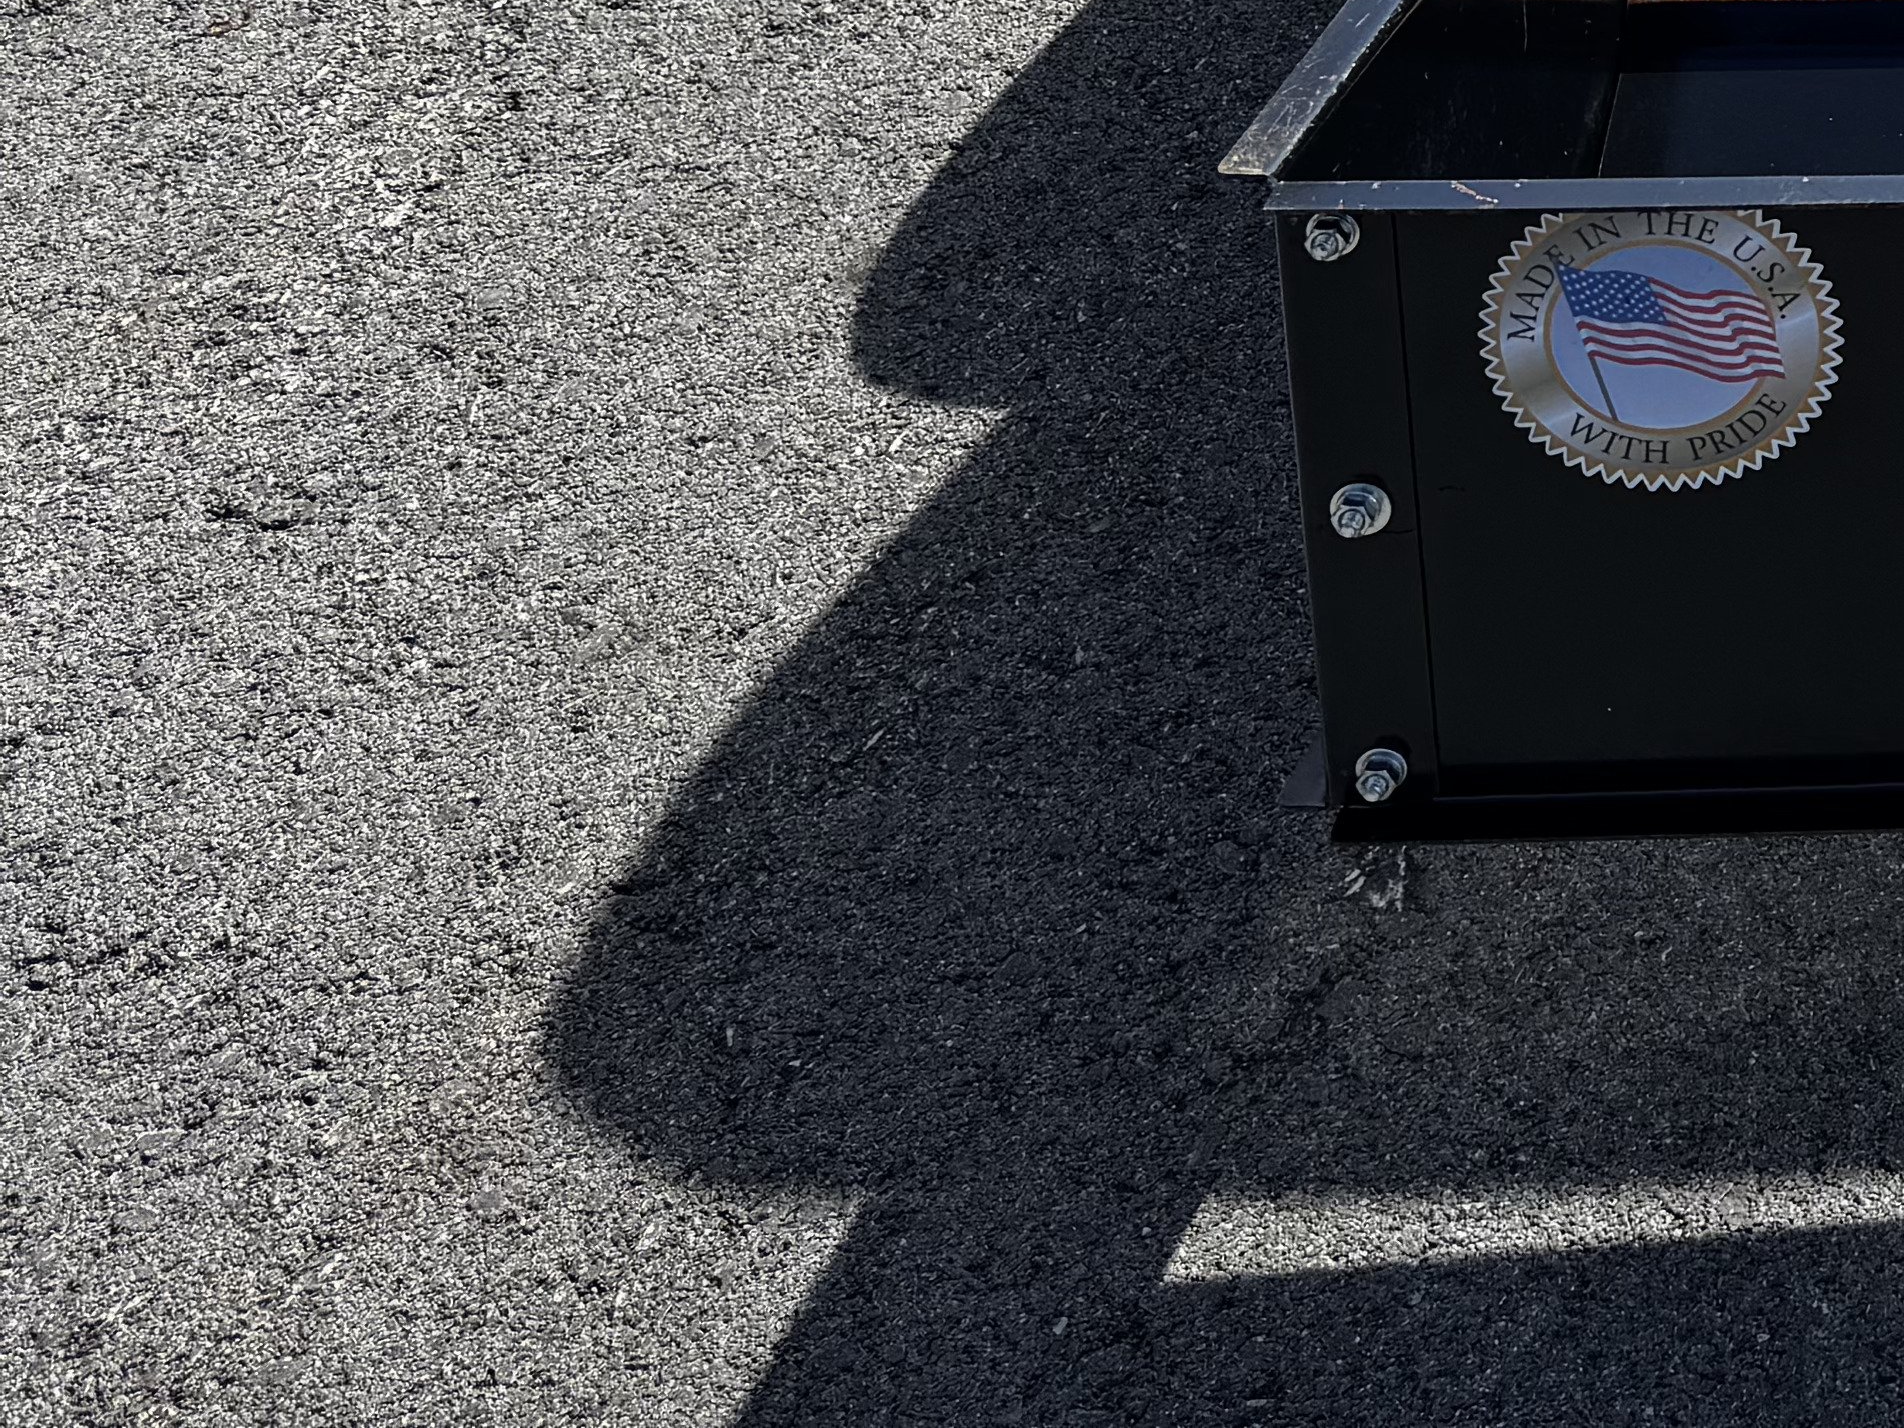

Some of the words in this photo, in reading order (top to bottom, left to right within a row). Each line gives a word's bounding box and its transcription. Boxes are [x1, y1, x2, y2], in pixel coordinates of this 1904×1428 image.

[1507, 244, 1575, 342] MADE
[1576, 215, 1620, 252] IN
[1636, 211, 1720, 244] THE
[1733, 235, 1802, 320] U.S.A.
[1570, 413, 1669, 464] WITH
[1686, 393, 1786, 461] PRIDE
